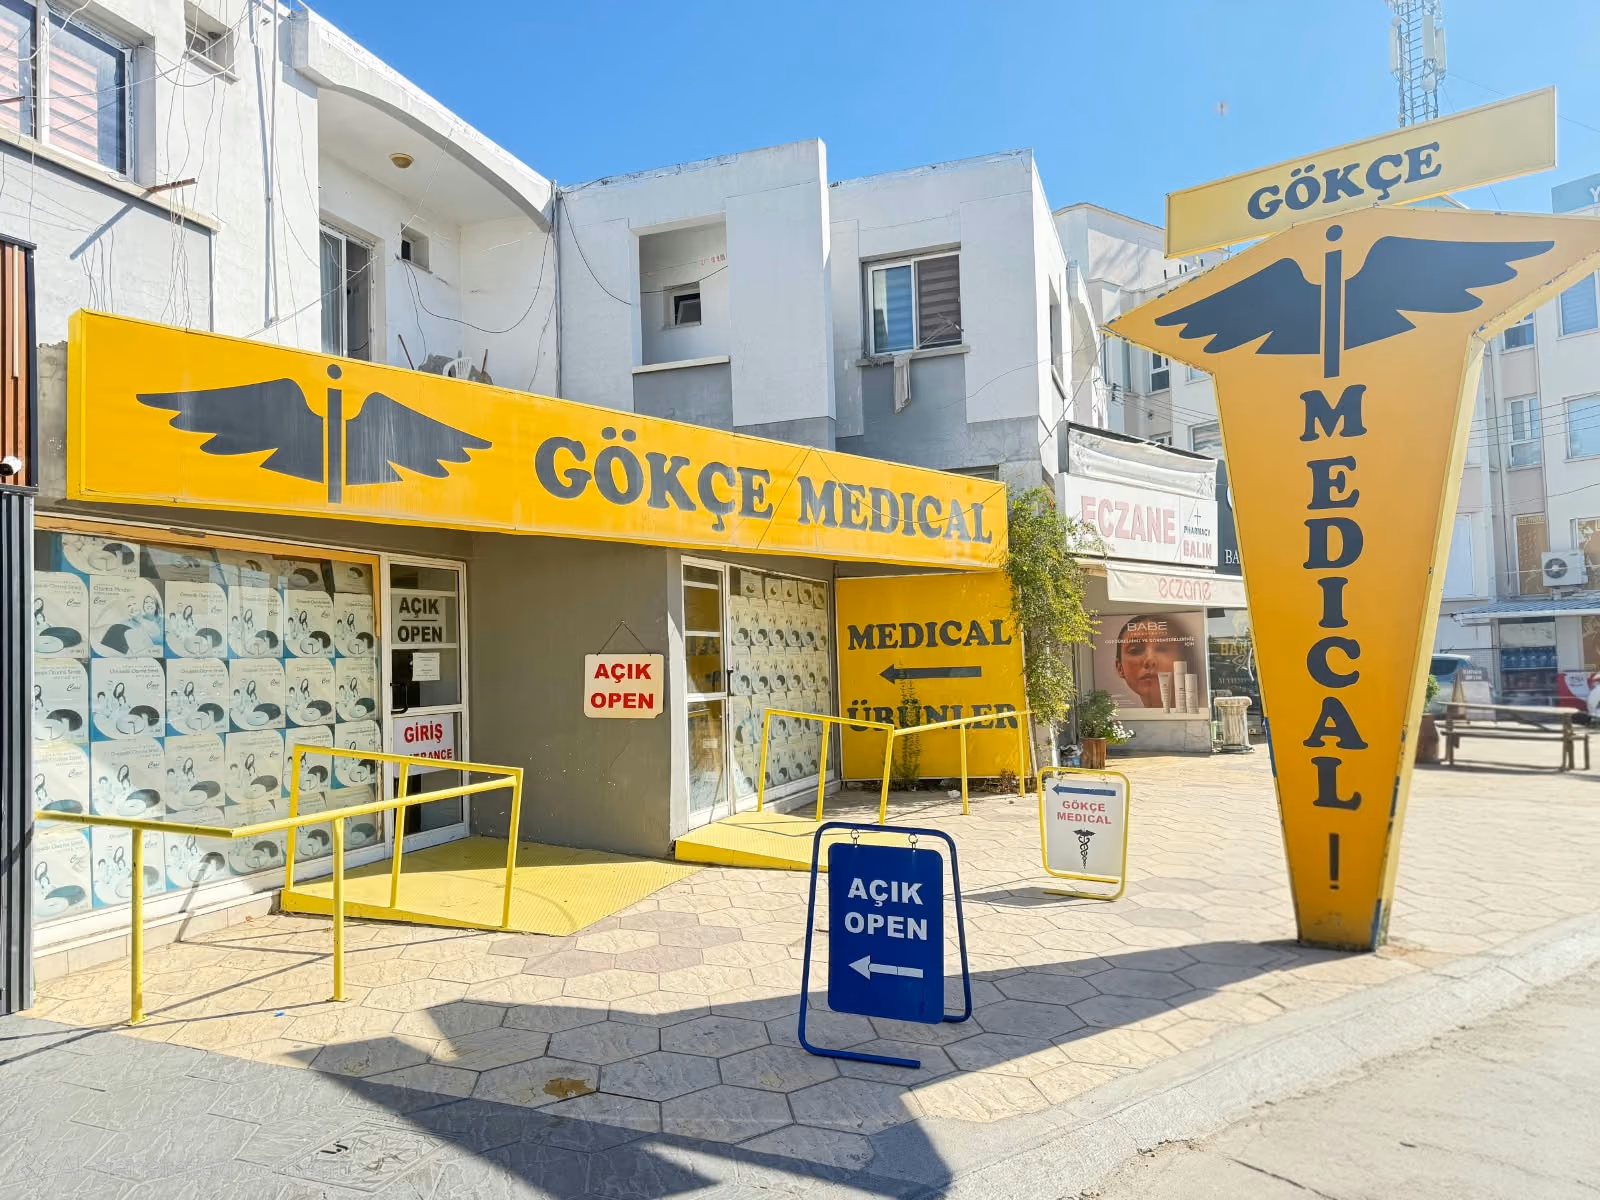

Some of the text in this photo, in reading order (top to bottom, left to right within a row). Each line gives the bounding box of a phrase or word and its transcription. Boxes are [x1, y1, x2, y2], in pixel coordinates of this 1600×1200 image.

[1247, 142, 1442, 219] GÖKÇE
[535, 426, 993, 544] GÖKÇE MEDICAL
[1081, 495, 1176, 545] ECZANE
[1158, 576, 1212, 601] eczane
[399, 597, 440, 618] AÇIK
[397, 626, 443, 643] OPEN
[847, 619, 1012, 650] MEDICAL
[594, 663, 652, 683] AÇIK
[591, 692, 654, 709] OPEN
[404, 721, 443, 744] GİRİŞ
[1057, 812, 1112, 825] MEDICAL
[1062, 799, 1106, 814] GÖKÇE
[848, 877, 924, 907] AÇIK
[844, 911, 928, 941] OPEN
